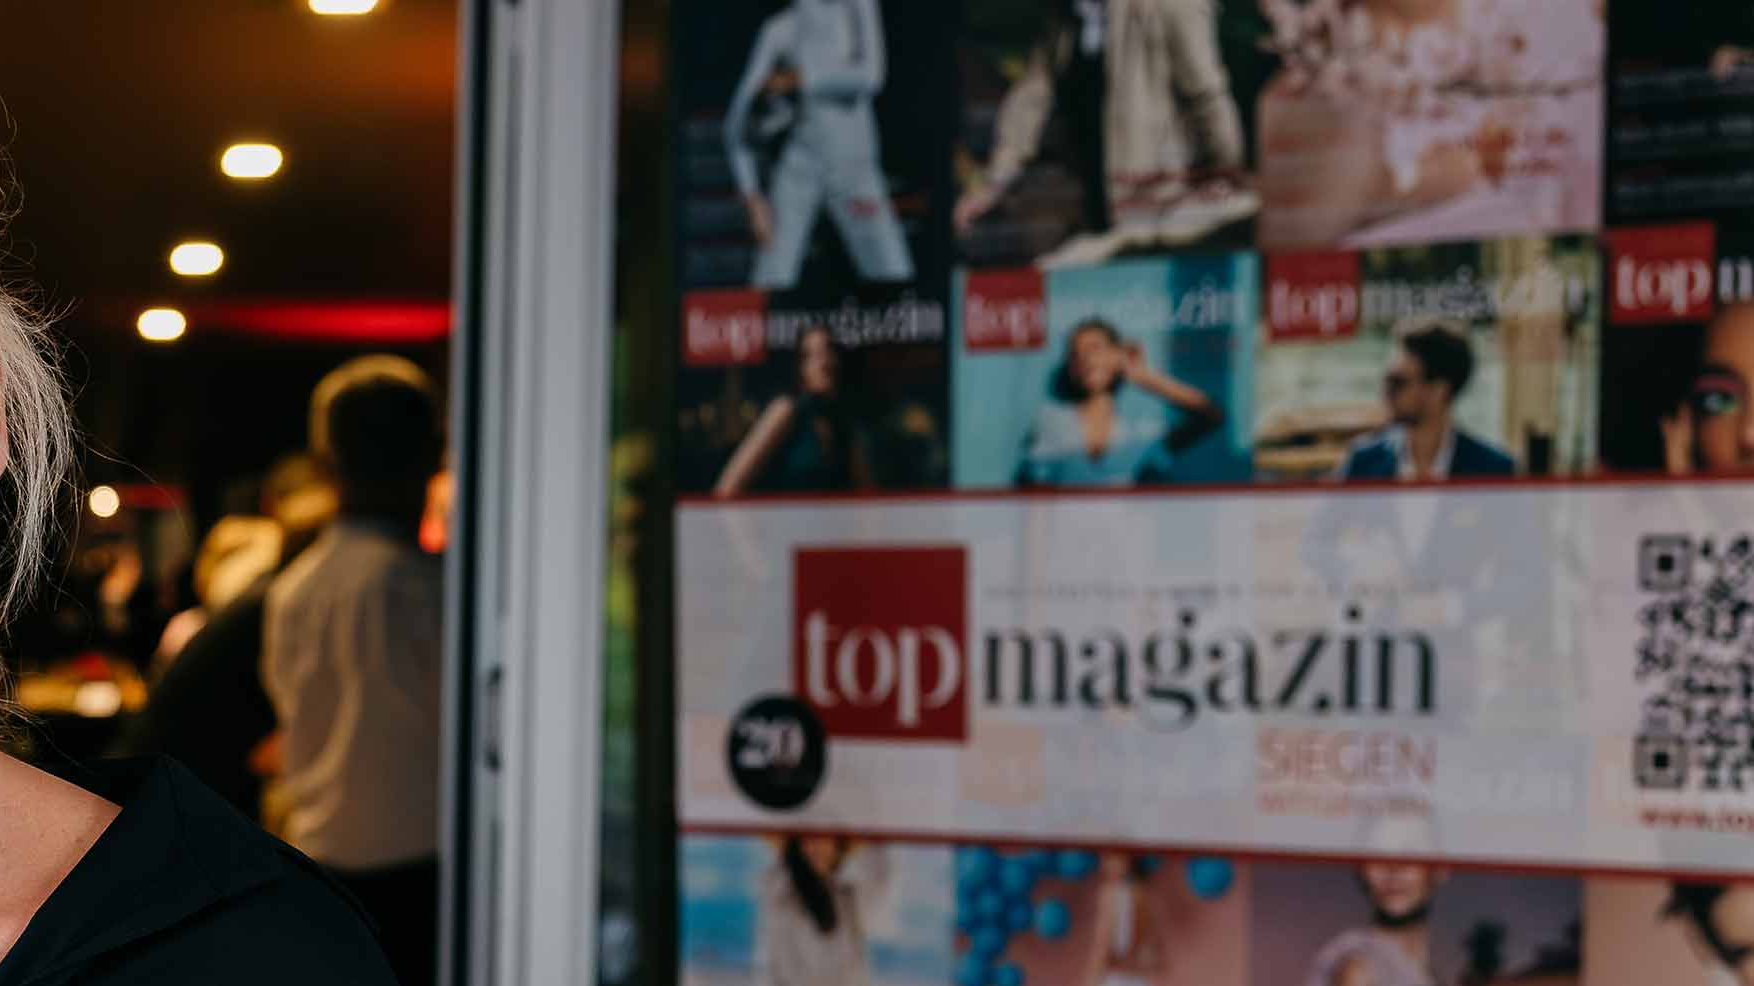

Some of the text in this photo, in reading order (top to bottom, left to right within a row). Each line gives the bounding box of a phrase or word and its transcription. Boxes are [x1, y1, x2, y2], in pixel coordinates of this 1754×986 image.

[1268, 278, 1358, 334] top
[1614, 253, 1712, 313] top
[802, 604, 1437, 732] top magazin
